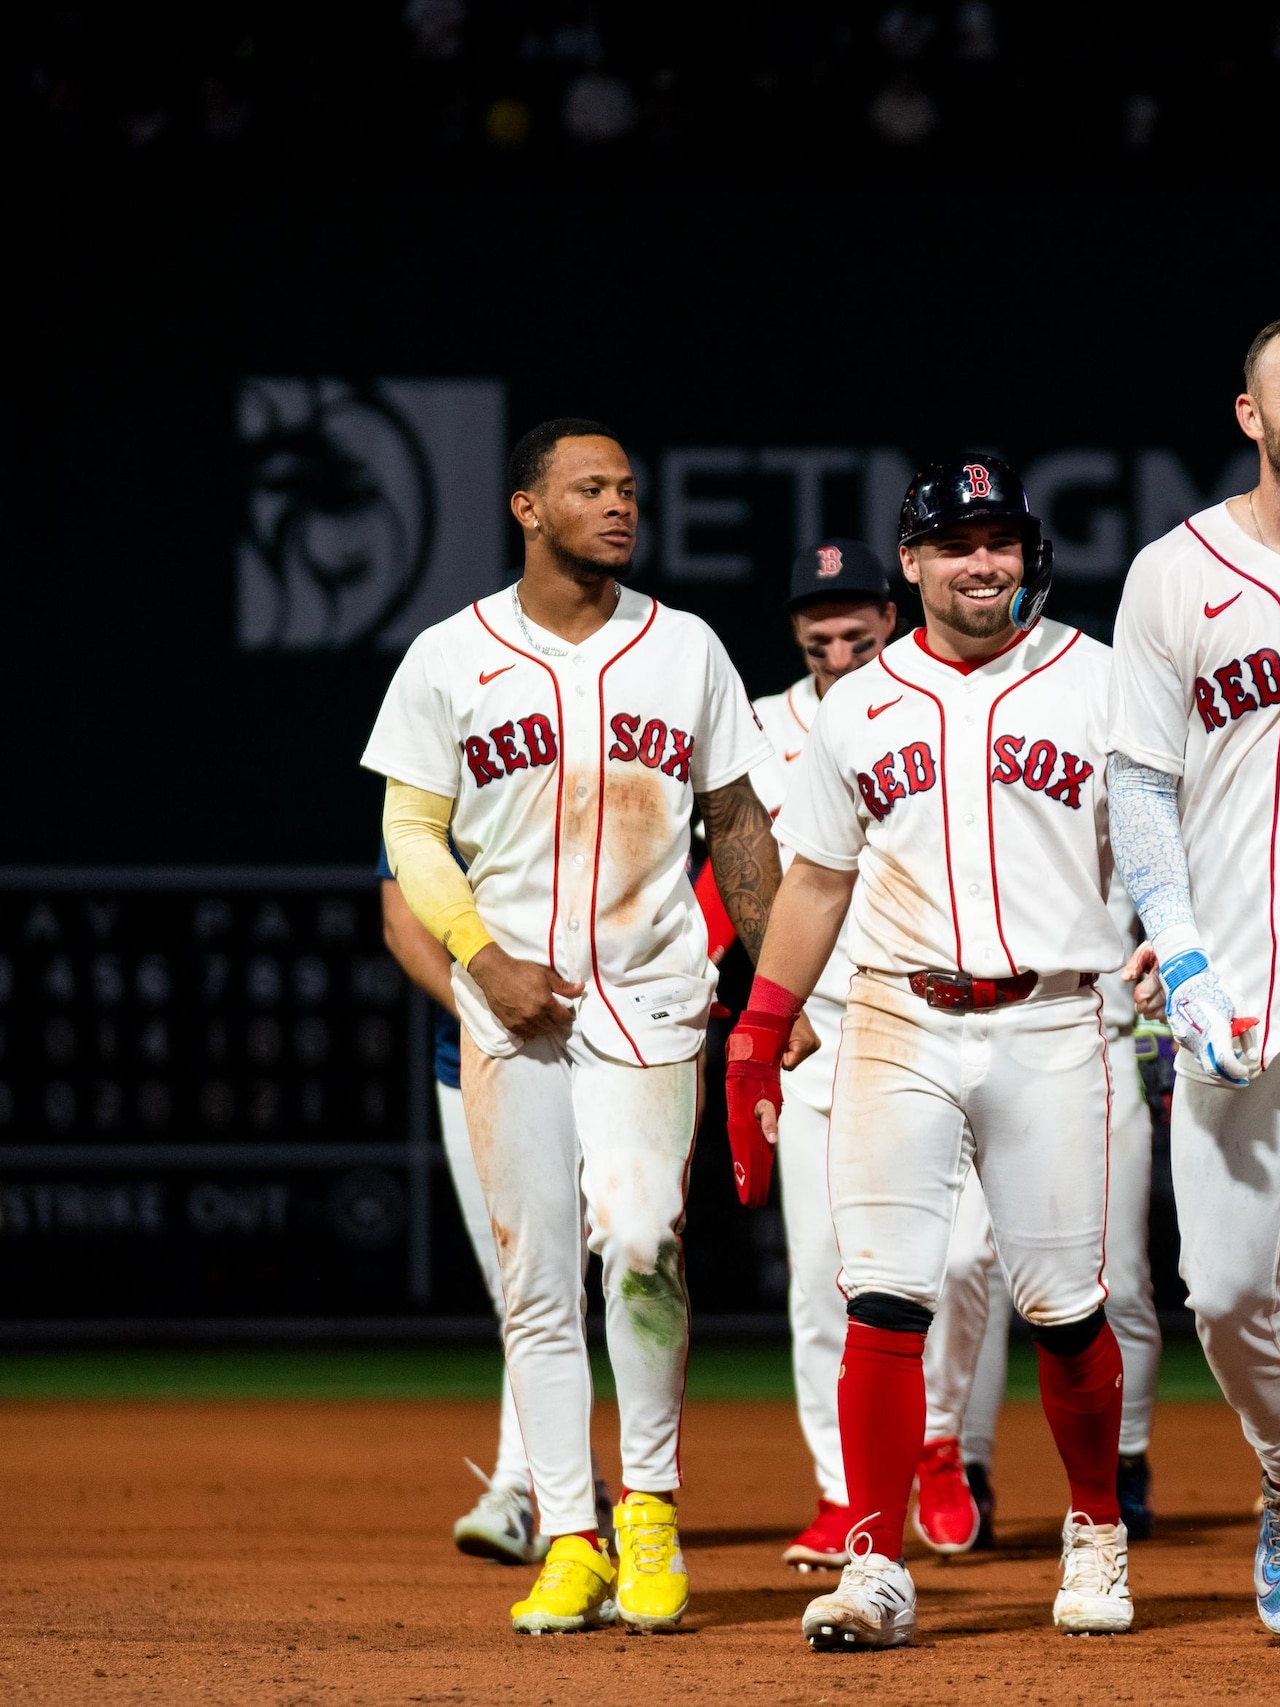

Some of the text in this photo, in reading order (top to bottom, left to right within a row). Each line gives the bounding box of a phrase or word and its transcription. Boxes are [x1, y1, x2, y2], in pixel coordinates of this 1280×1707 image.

[963, 464, 992, 498] B
[816, 546, 843, 578] B
[464, 713, 694, 788] RED SOX
[857, 735, 1094, 822] RED SOX
